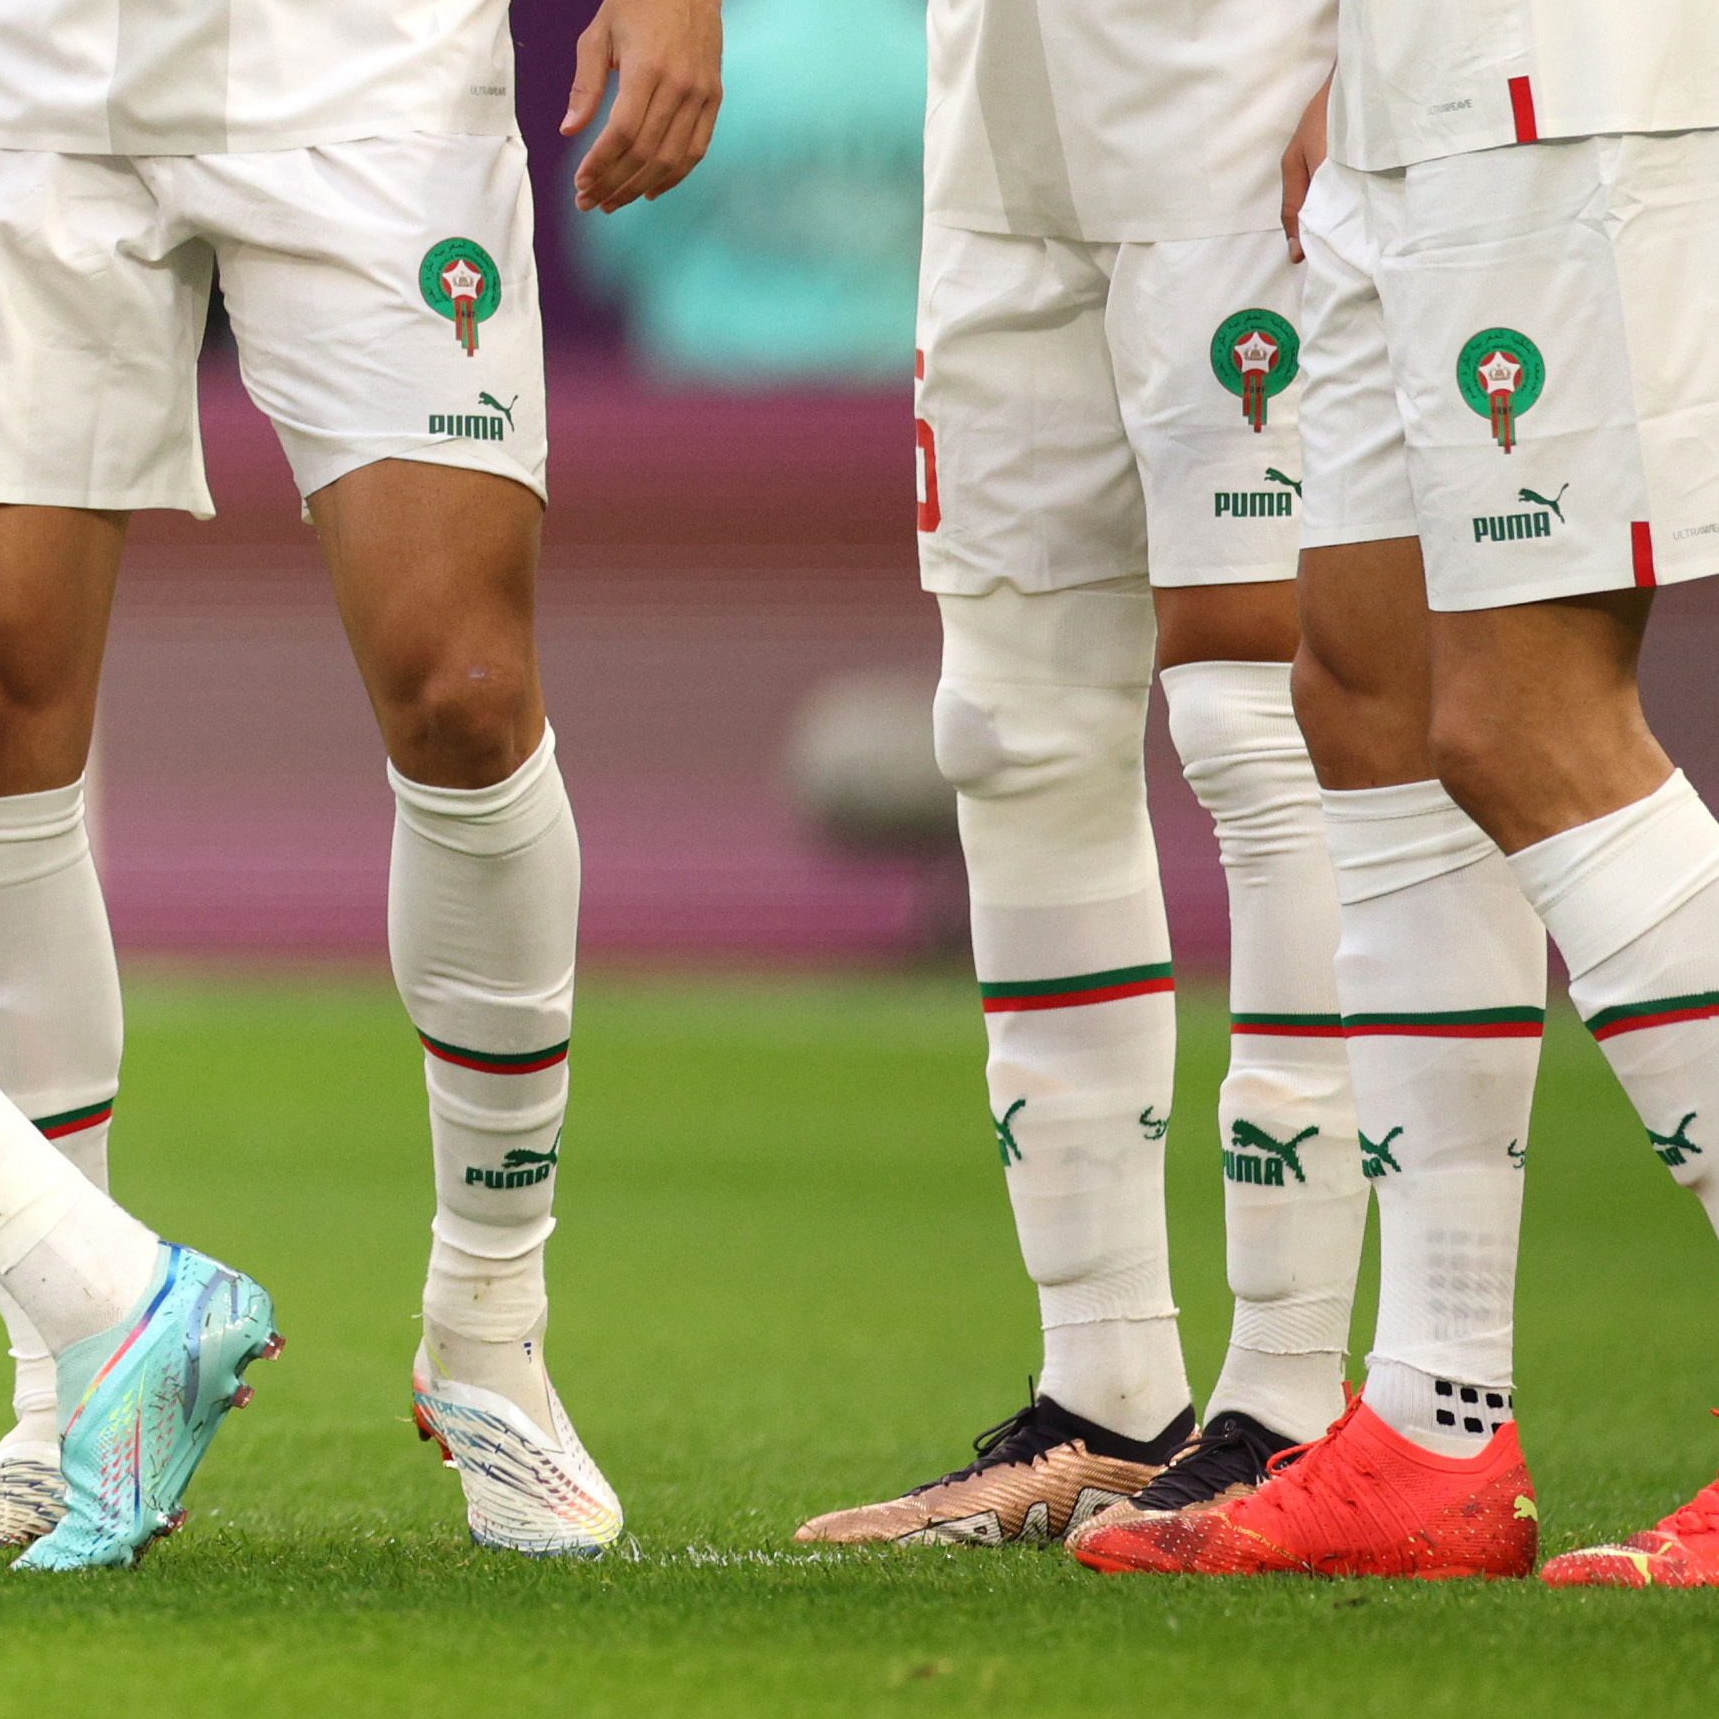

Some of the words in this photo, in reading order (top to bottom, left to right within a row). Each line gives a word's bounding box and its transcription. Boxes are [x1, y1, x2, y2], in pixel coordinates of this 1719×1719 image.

[429, 414, 504, 441] PUMA
[1214, 492, 1292, 517] PUMA
[1472, 511, 1551, 543] PUMA
[465, 1163, 550, 1189] PUMA
